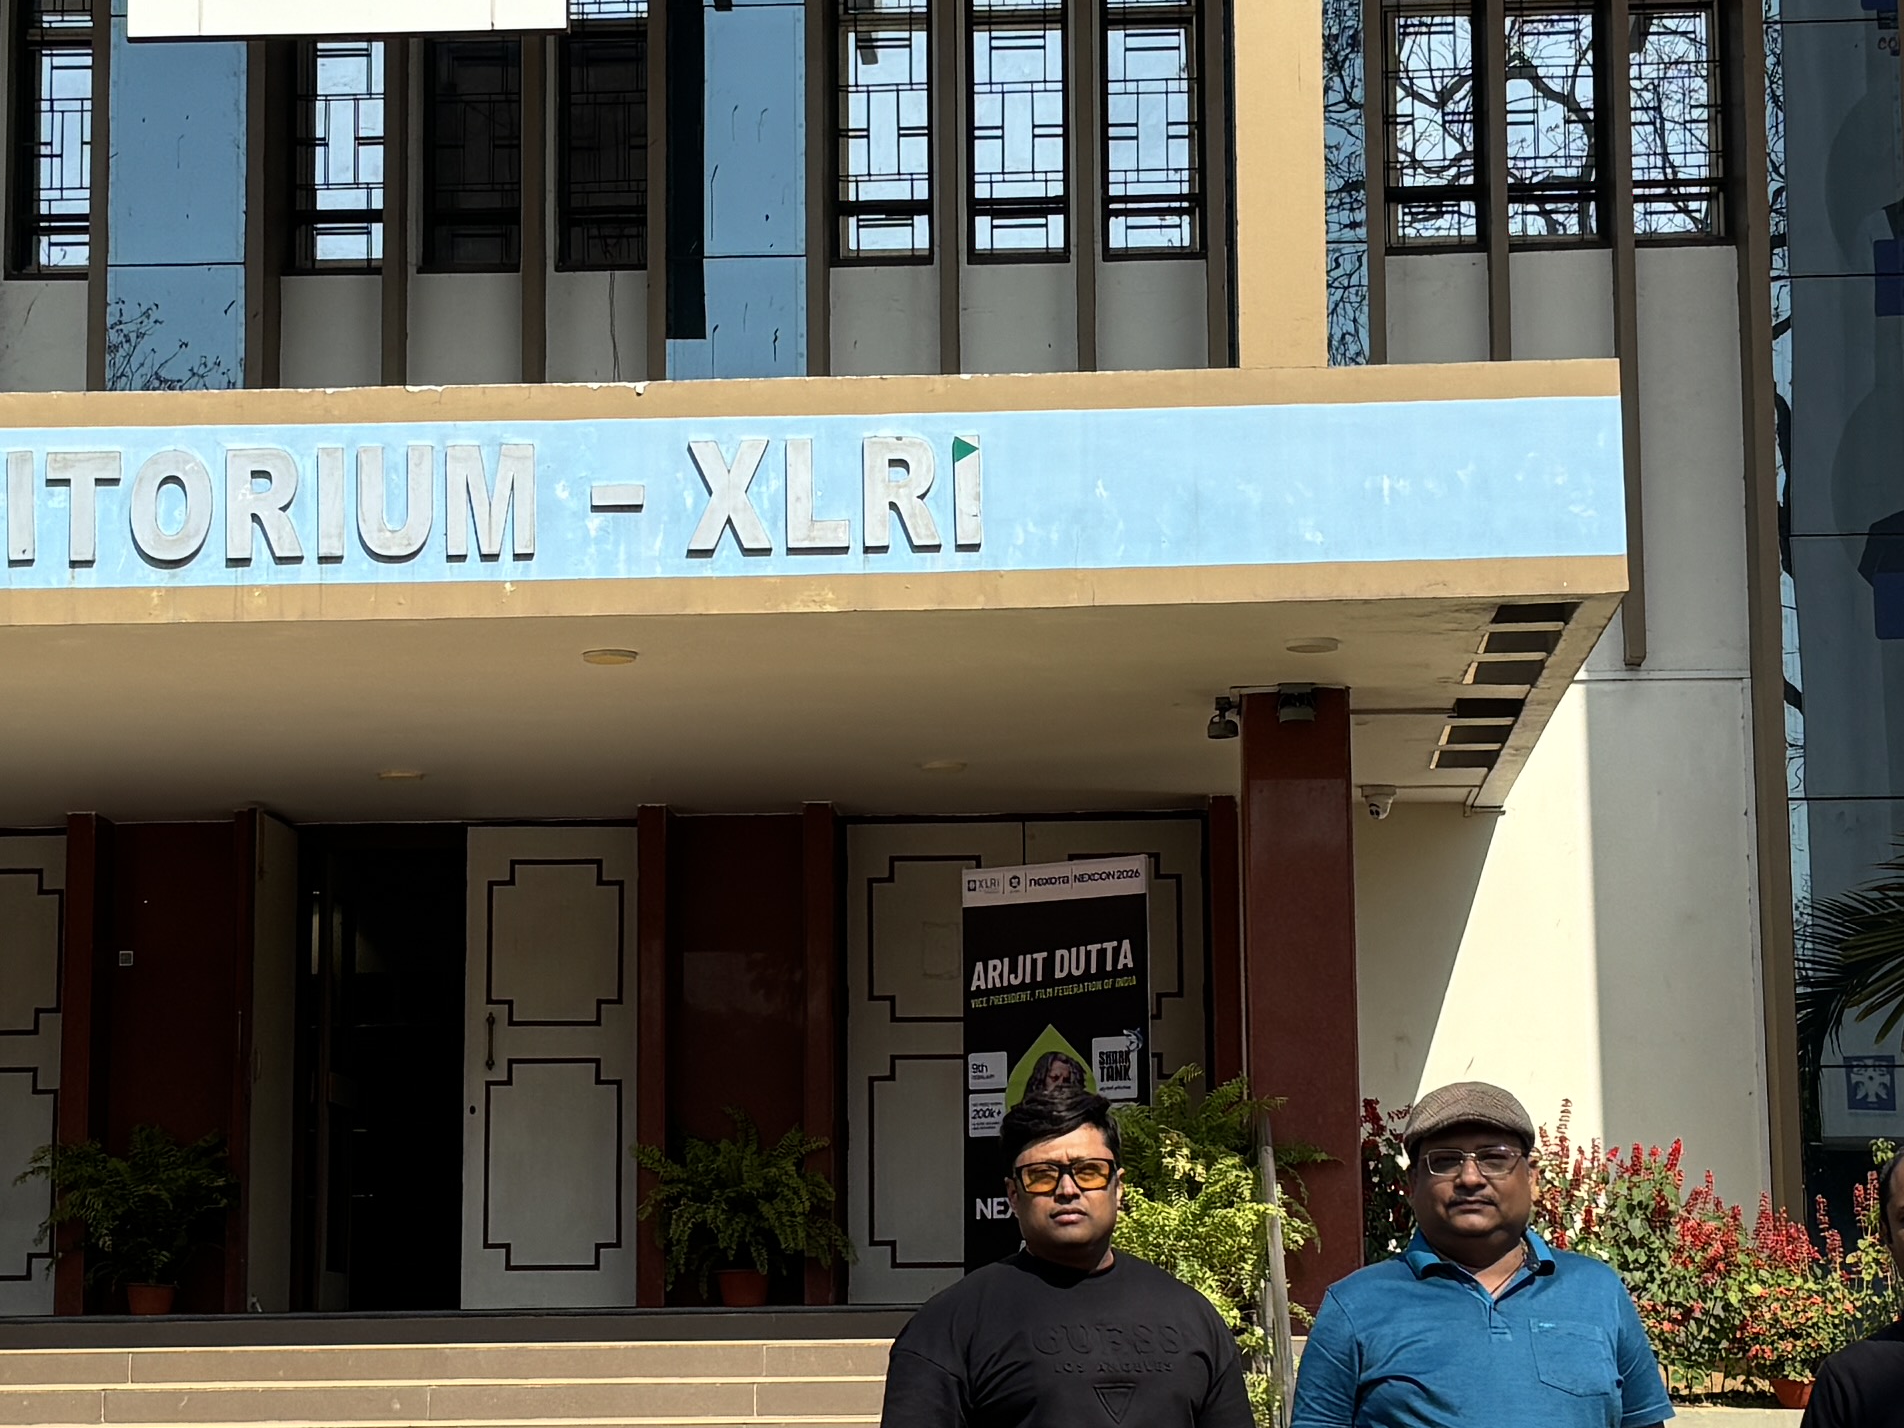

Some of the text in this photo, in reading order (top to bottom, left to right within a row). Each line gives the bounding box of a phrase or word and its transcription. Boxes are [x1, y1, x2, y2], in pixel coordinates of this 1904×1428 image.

[1116, 868, 1141, 880] 2026
[970, 938, 1134, 991] ARIJIT DUTTA
